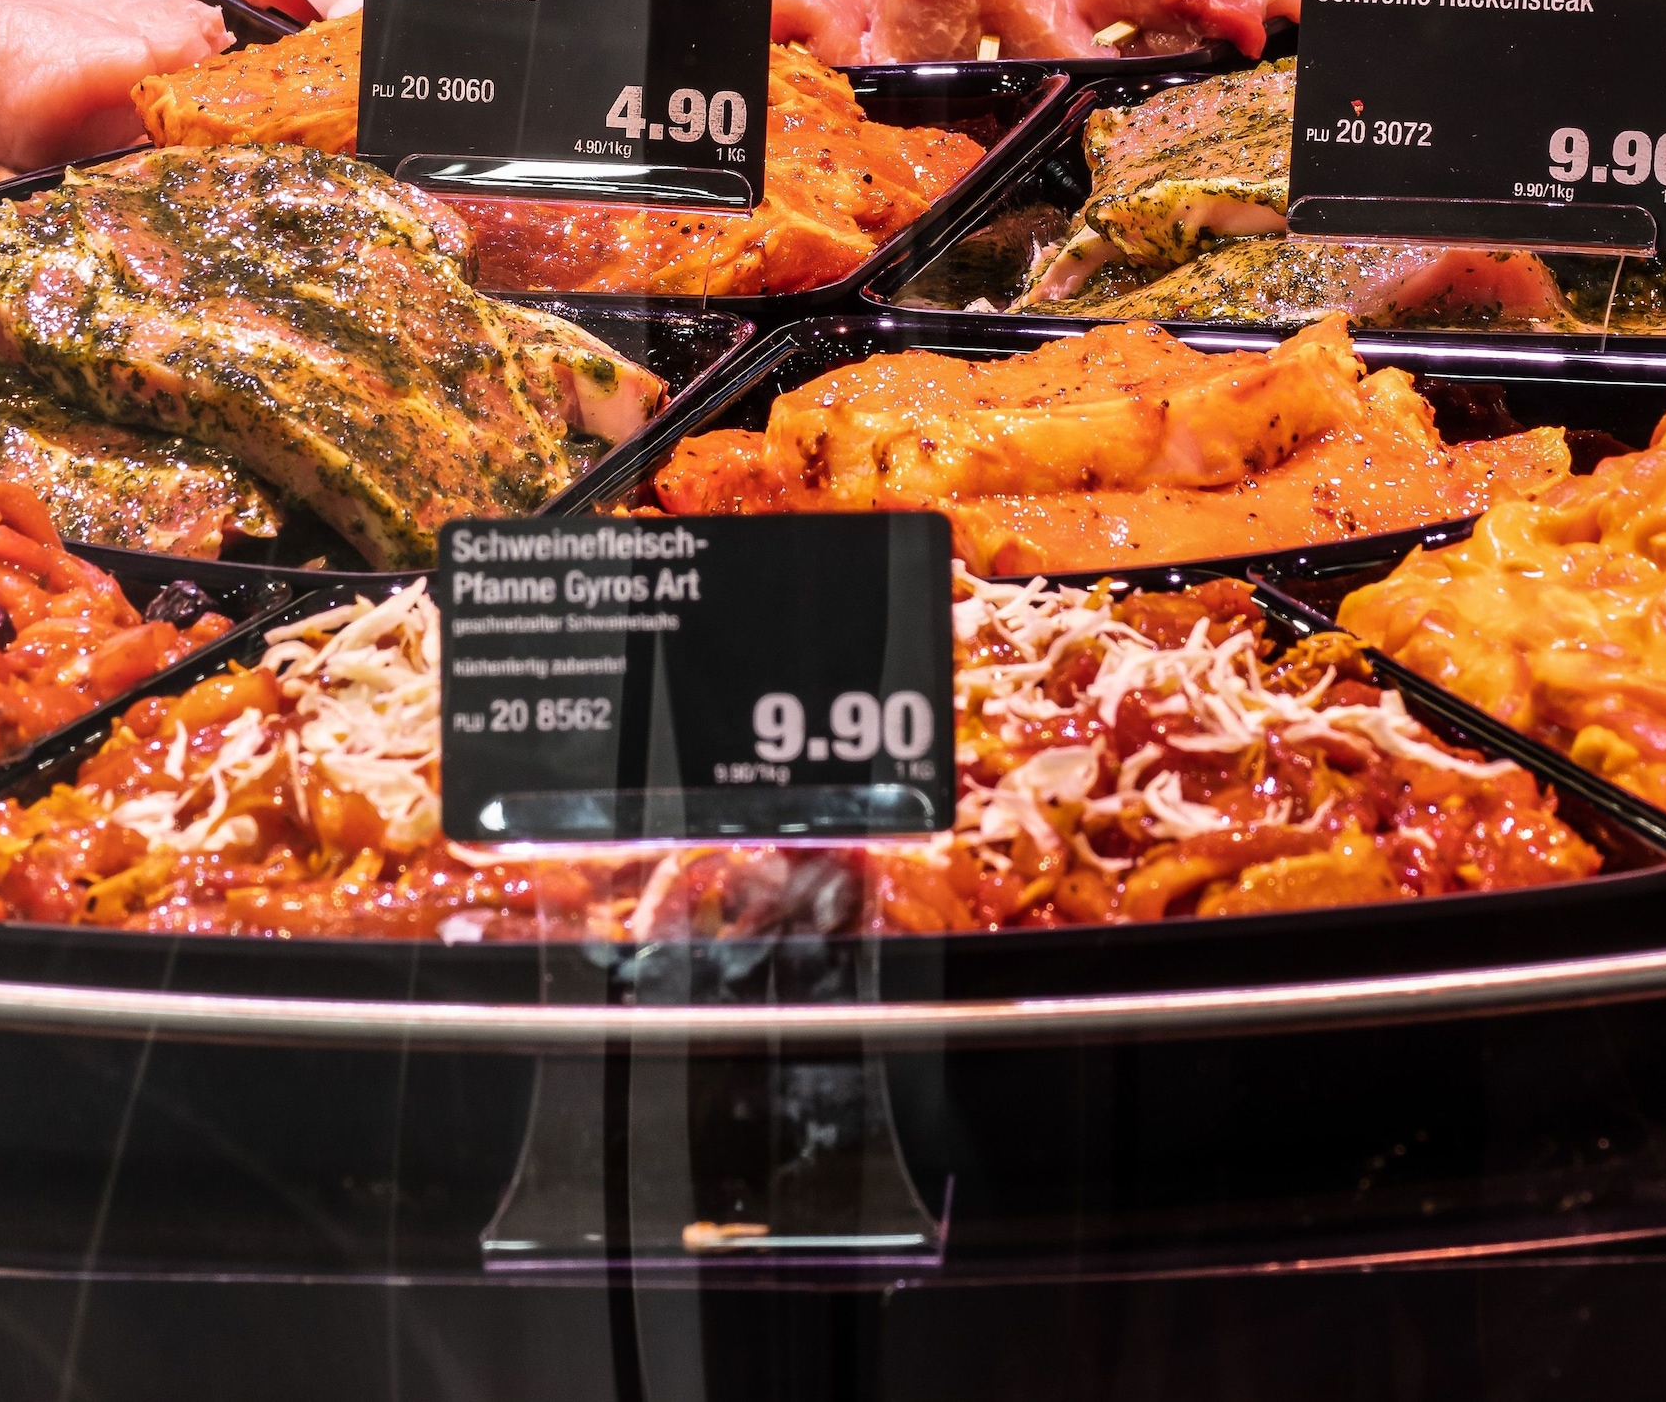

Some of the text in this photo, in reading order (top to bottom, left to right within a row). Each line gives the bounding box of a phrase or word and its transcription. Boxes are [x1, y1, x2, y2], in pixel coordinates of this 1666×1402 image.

[372, 75, 494, 103] PLU 20 3060
[605, 85, 747, 145] 4.90
[1306, 119, 1432, 146] PLU 20 3072
[574, 138, 633, 158] 4.90/1kg
[728, 147, 745, 162] KG
[1514, 182, 1575, 202] 9.90/1kg
[452, 527, 707, 563] Schweinefleisch-
[453, 568, 699, 608] Pfanne Gyros Art
[491, 699, 528, 731] 20
[536, 698, 611, 730] 8562
[753, 691, 933, 762] 9.90
